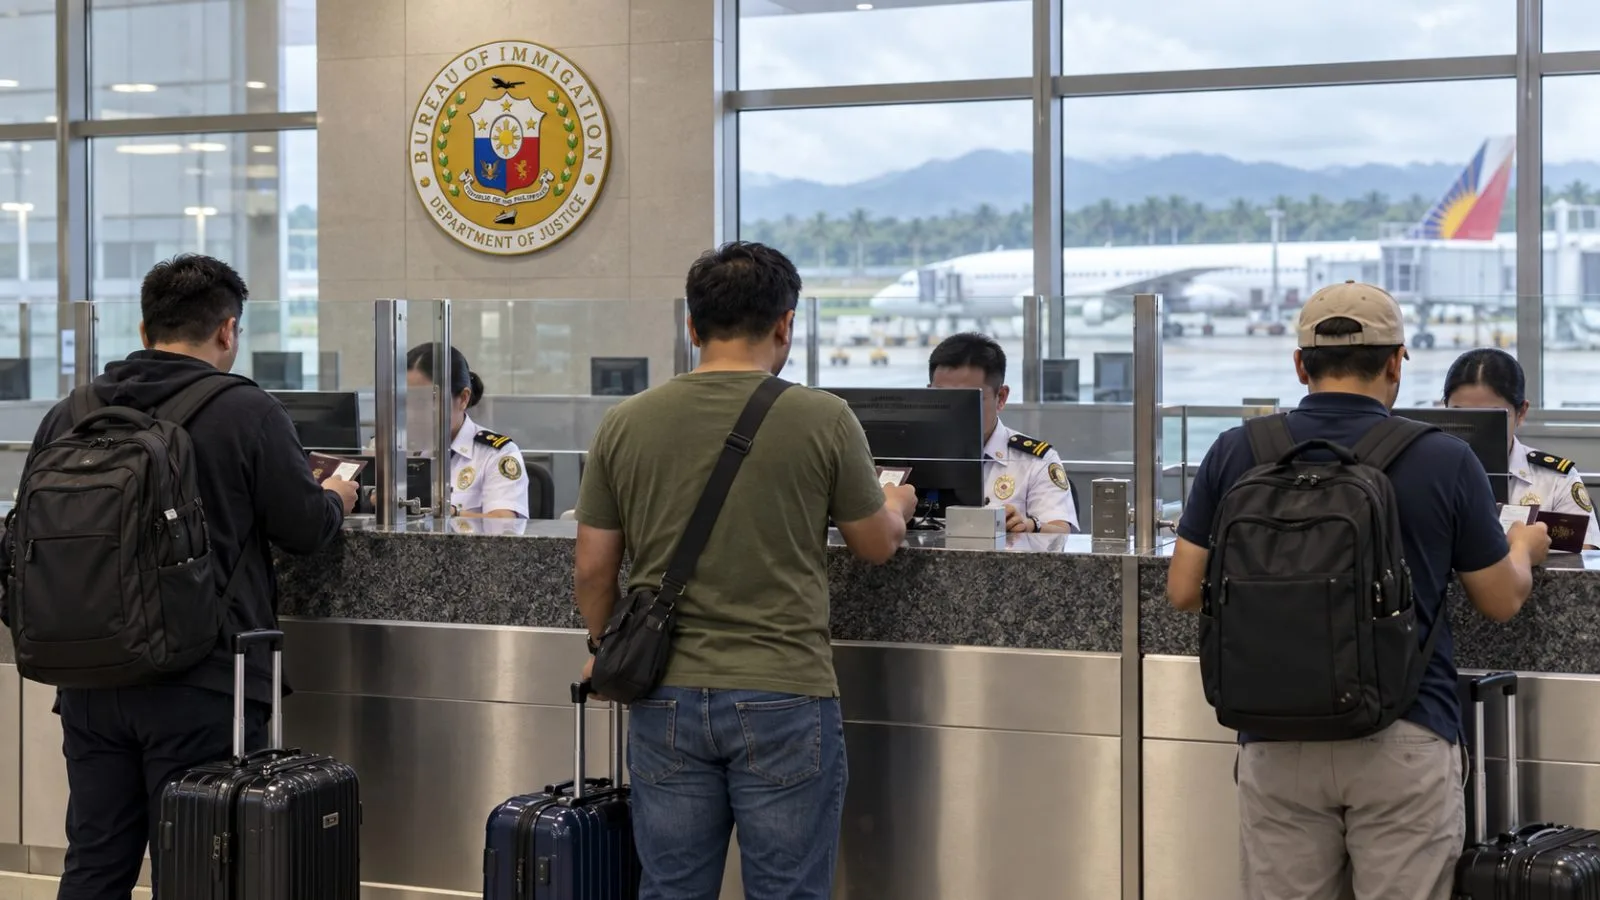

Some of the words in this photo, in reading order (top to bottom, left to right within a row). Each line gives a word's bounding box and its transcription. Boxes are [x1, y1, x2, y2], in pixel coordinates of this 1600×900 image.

[415, 69, 459, 163] BUREAU
[464, 50, 489, 71] OF
[499, 46, 602, 160] IMMIGATION
[430, 196, 513, 248] DEPARTMENT
[517, 231, 535, 247] OF
[540, 194, 587, 241] JUSTICE
